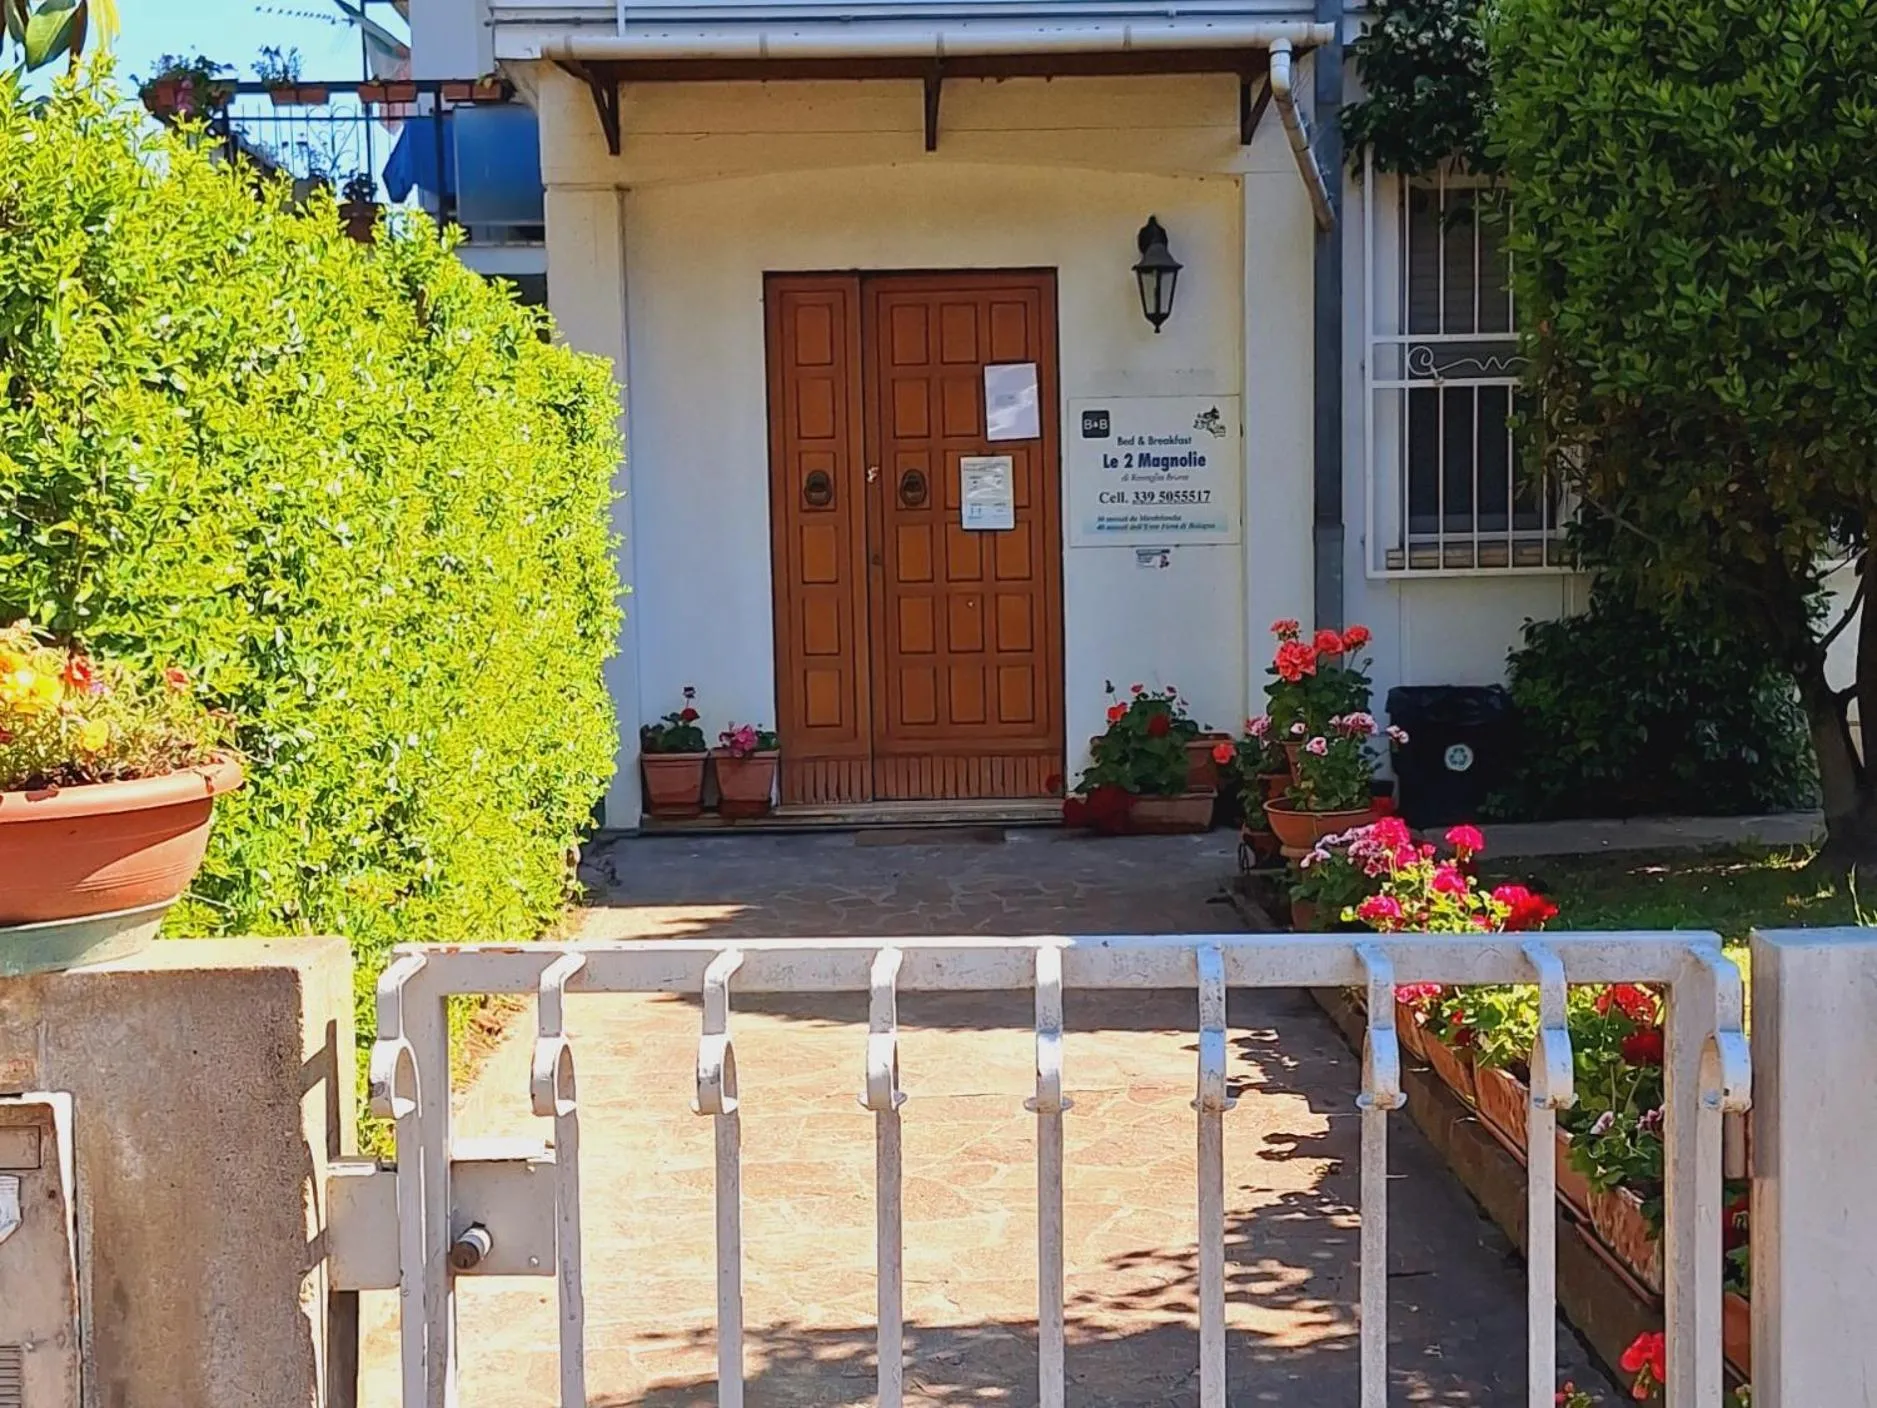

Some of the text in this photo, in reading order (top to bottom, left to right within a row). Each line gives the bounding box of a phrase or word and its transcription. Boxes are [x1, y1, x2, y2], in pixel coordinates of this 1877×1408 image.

[1117, 435, 1192, 446] Bed & Breakfast
[1103, 451, 1207, 472] Le 2 Magnolie
[1099, 490, 1211, 504] Cell. 339 5055517
